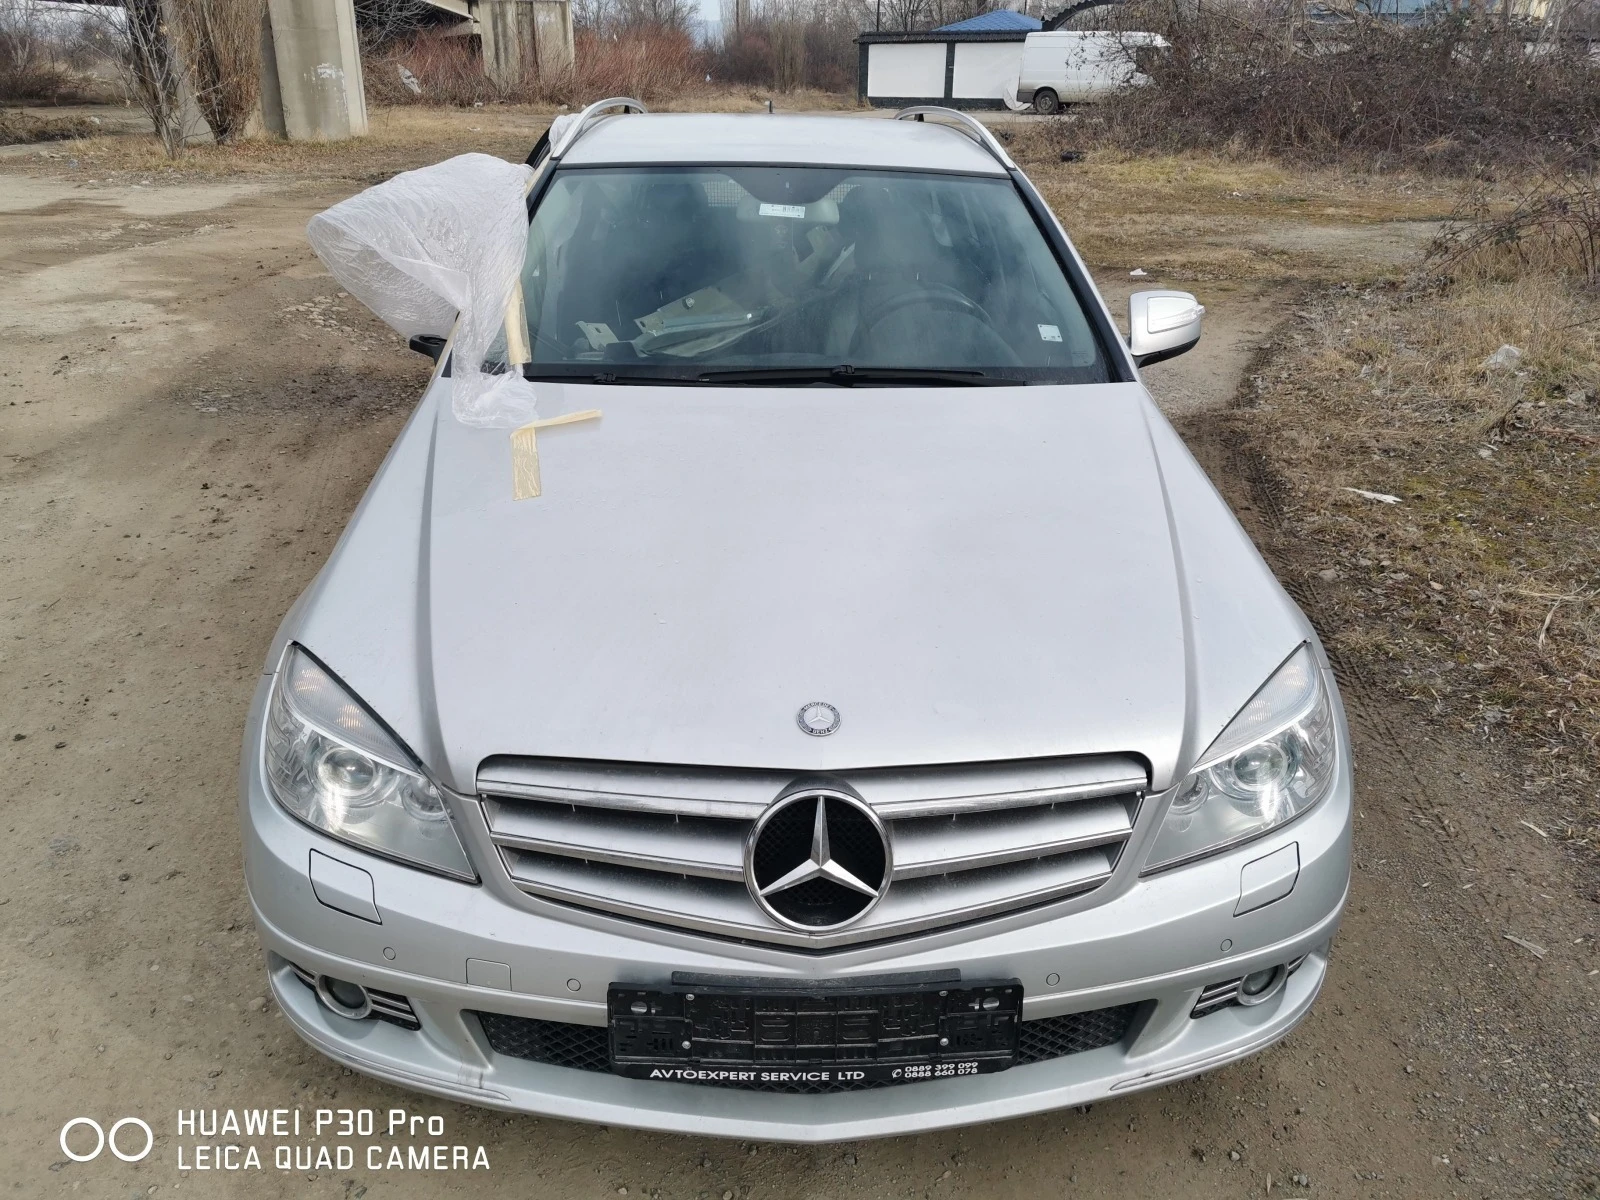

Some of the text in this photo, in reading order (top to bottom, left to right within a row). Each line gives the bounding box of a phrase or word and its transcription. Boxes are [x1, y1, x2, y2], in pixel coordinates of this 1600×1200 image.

[934, 1063, 955, 1071] 399
[649, 1069, 865, 1081] AVTOEXPERT SERVICE LTD
